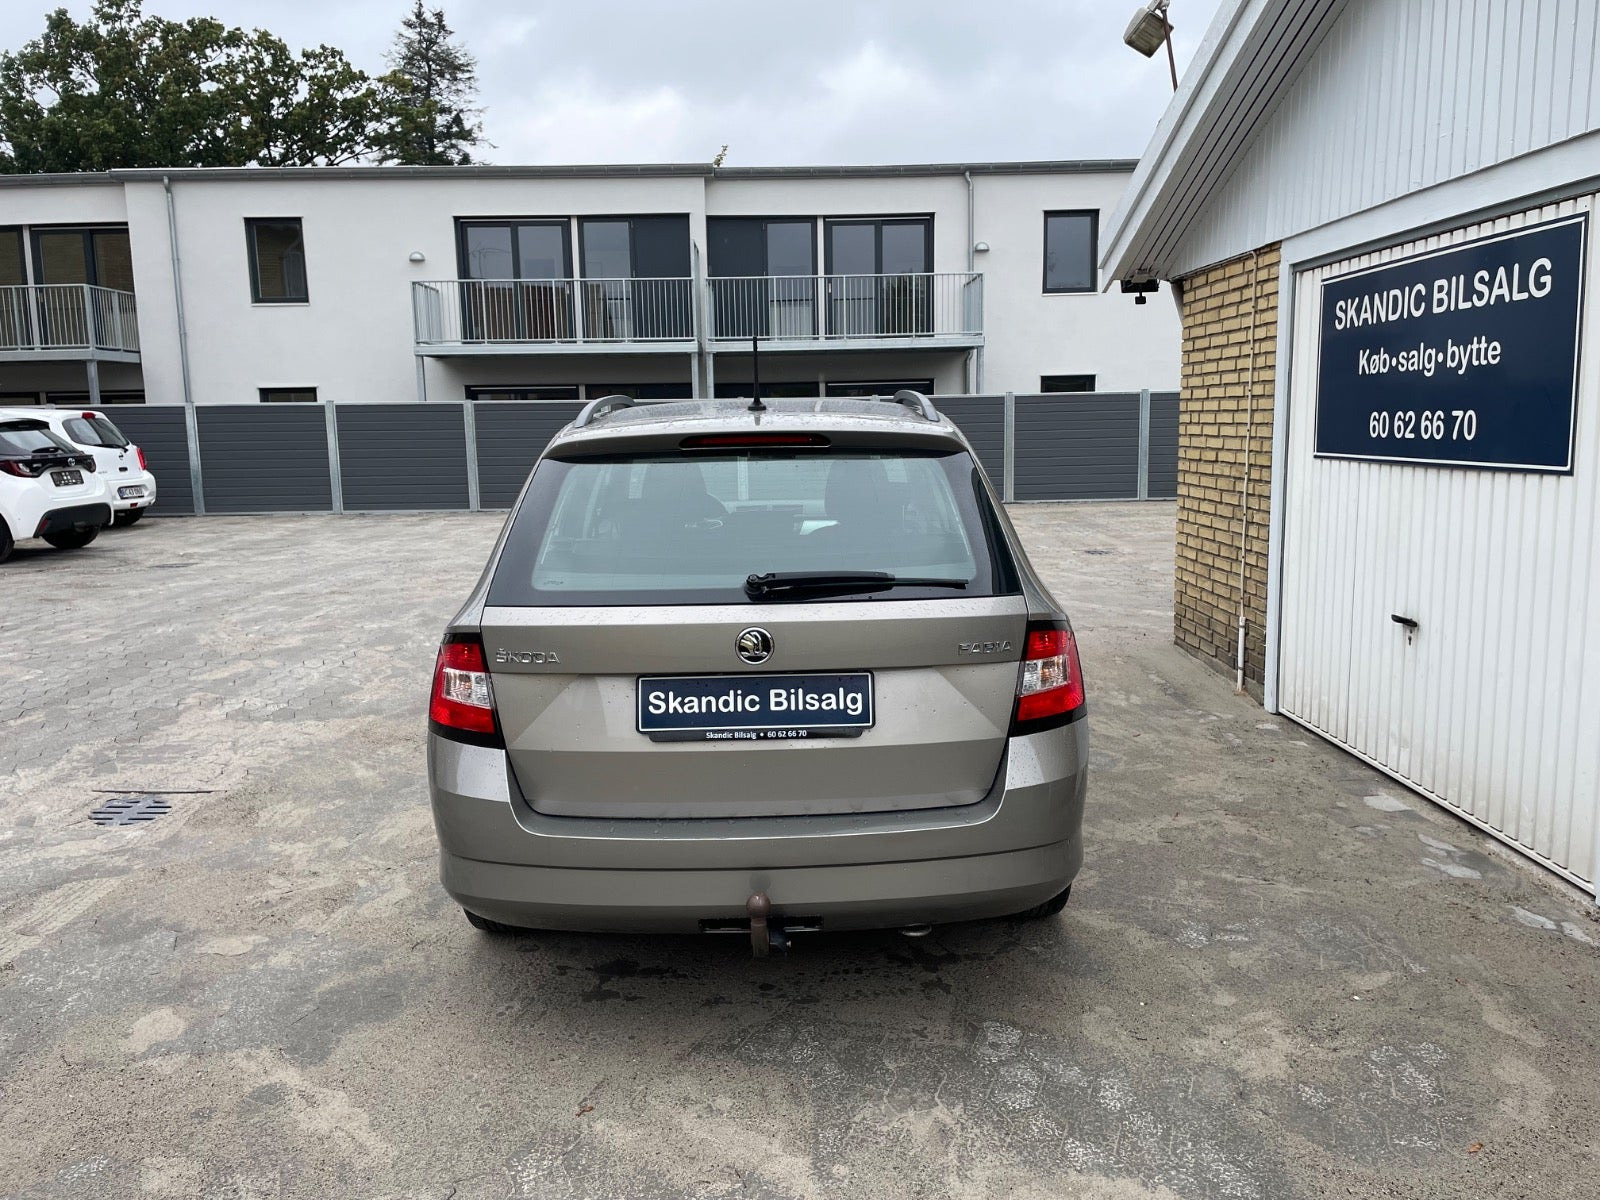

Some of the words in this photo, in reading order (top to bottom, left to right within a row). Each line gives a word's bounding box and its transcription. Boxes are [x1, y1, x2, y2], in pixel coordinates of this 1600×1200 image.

[1334, 282, 1426, 330] SKANDIC
[1432, 257, 1552, 314] BILSALG
[1369, 411, 1390, 439] 60
[1393, 410, 1415, 439] 62
[1420, 410, 1445, 440] 66
[1451, 409, 1477, 441] 70
[496, 647, 561, 664] ŠKODA
[958, 640, 1013, 655] FABIA
[648, 690, 760, 715] Skandic
[769, 687, 863, 715] Bilsalg
[705, 731, 733, 739] Skandic
[734, 731, 757, 739] Bilsalg
[767, 730, 777, 738] 60
[778, 730, 787, 738] 62
[798, 729, 807, 737] 70
